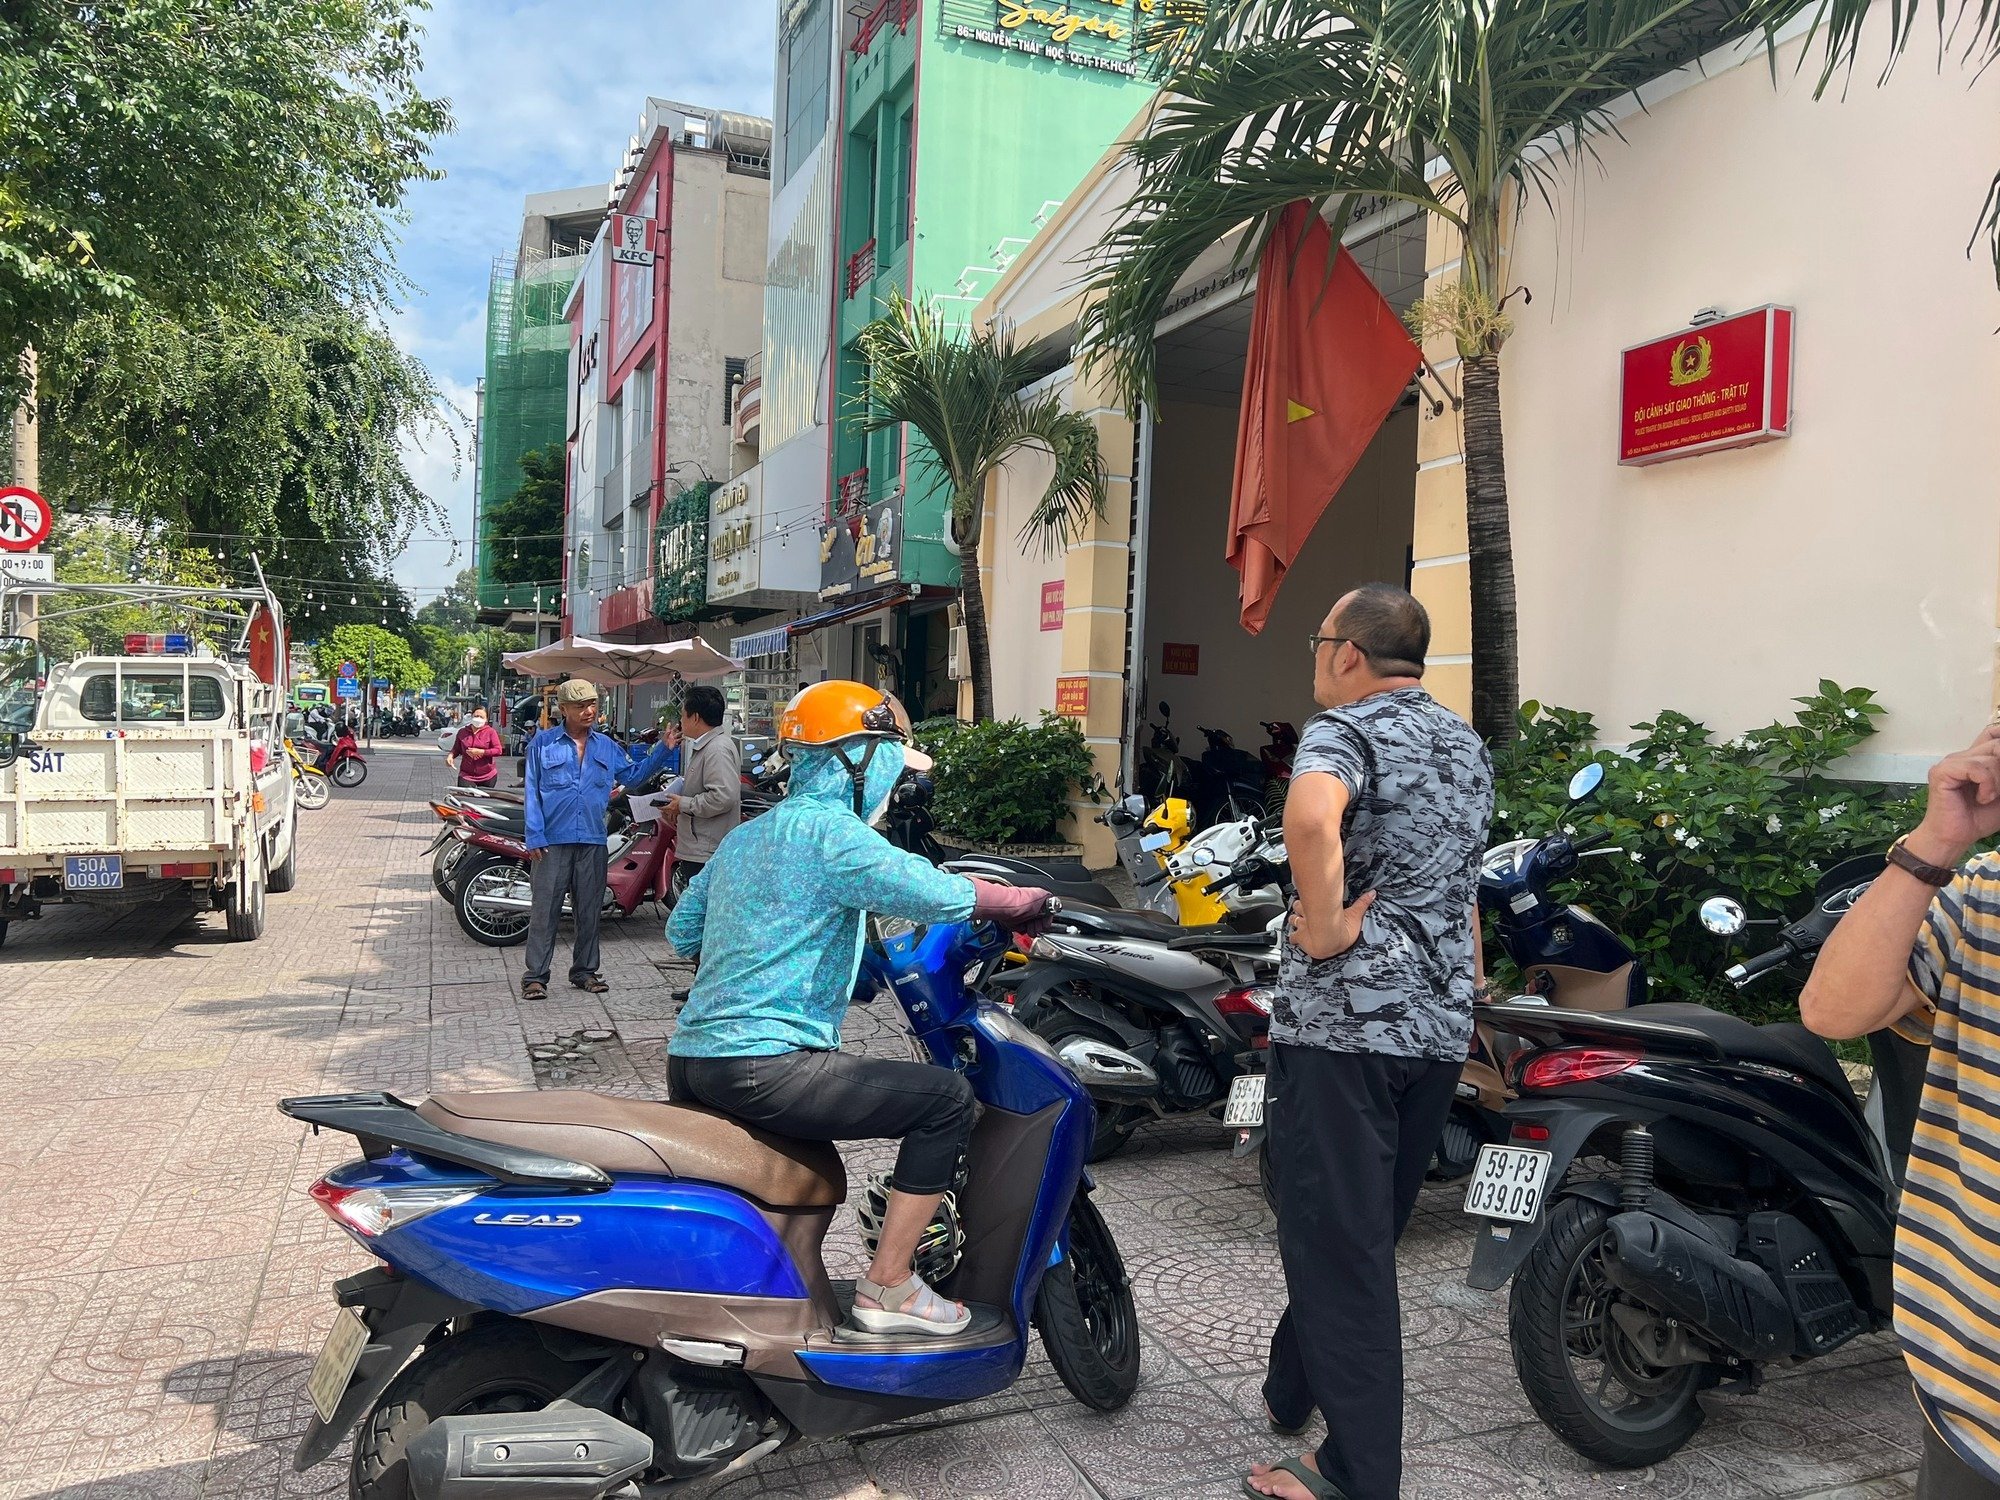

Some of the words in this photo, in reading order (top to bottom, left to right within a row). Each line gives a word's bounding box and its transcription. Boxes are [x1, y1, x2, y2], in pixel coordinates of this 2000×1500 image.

[957, 25, 969, 38] 86
[1018, 38, 1040, 54] THÁI
[619, 249, 648, 262] KFC
[1634, 406, 1646, 423] ĐỘI
[1646, 402, 1664, 420] CẢNH
[1664, 399, 1676, 415] SÁT
[1676, 397, 1692, 412] GIAO
[1693, 390, 1716, 407] THÔNG
[1721, 383, 1738, 401] TRẬT
[1739, 382, 1749, 398] TỰ
[21, 560, 43, 570] 9:00
[29, 748, 65, 773] SÁT
[78, 858, 108, 872] 50A
[67, 872, 120, 888] 009.07
[1227, 1101, 1264, 1122] 842.30
[1485, 1151, 1539, 1183] 59-P3
[1471, 1181, 1537, 1217] 039.09
[473, 1213, 582, 1228] LEAD
